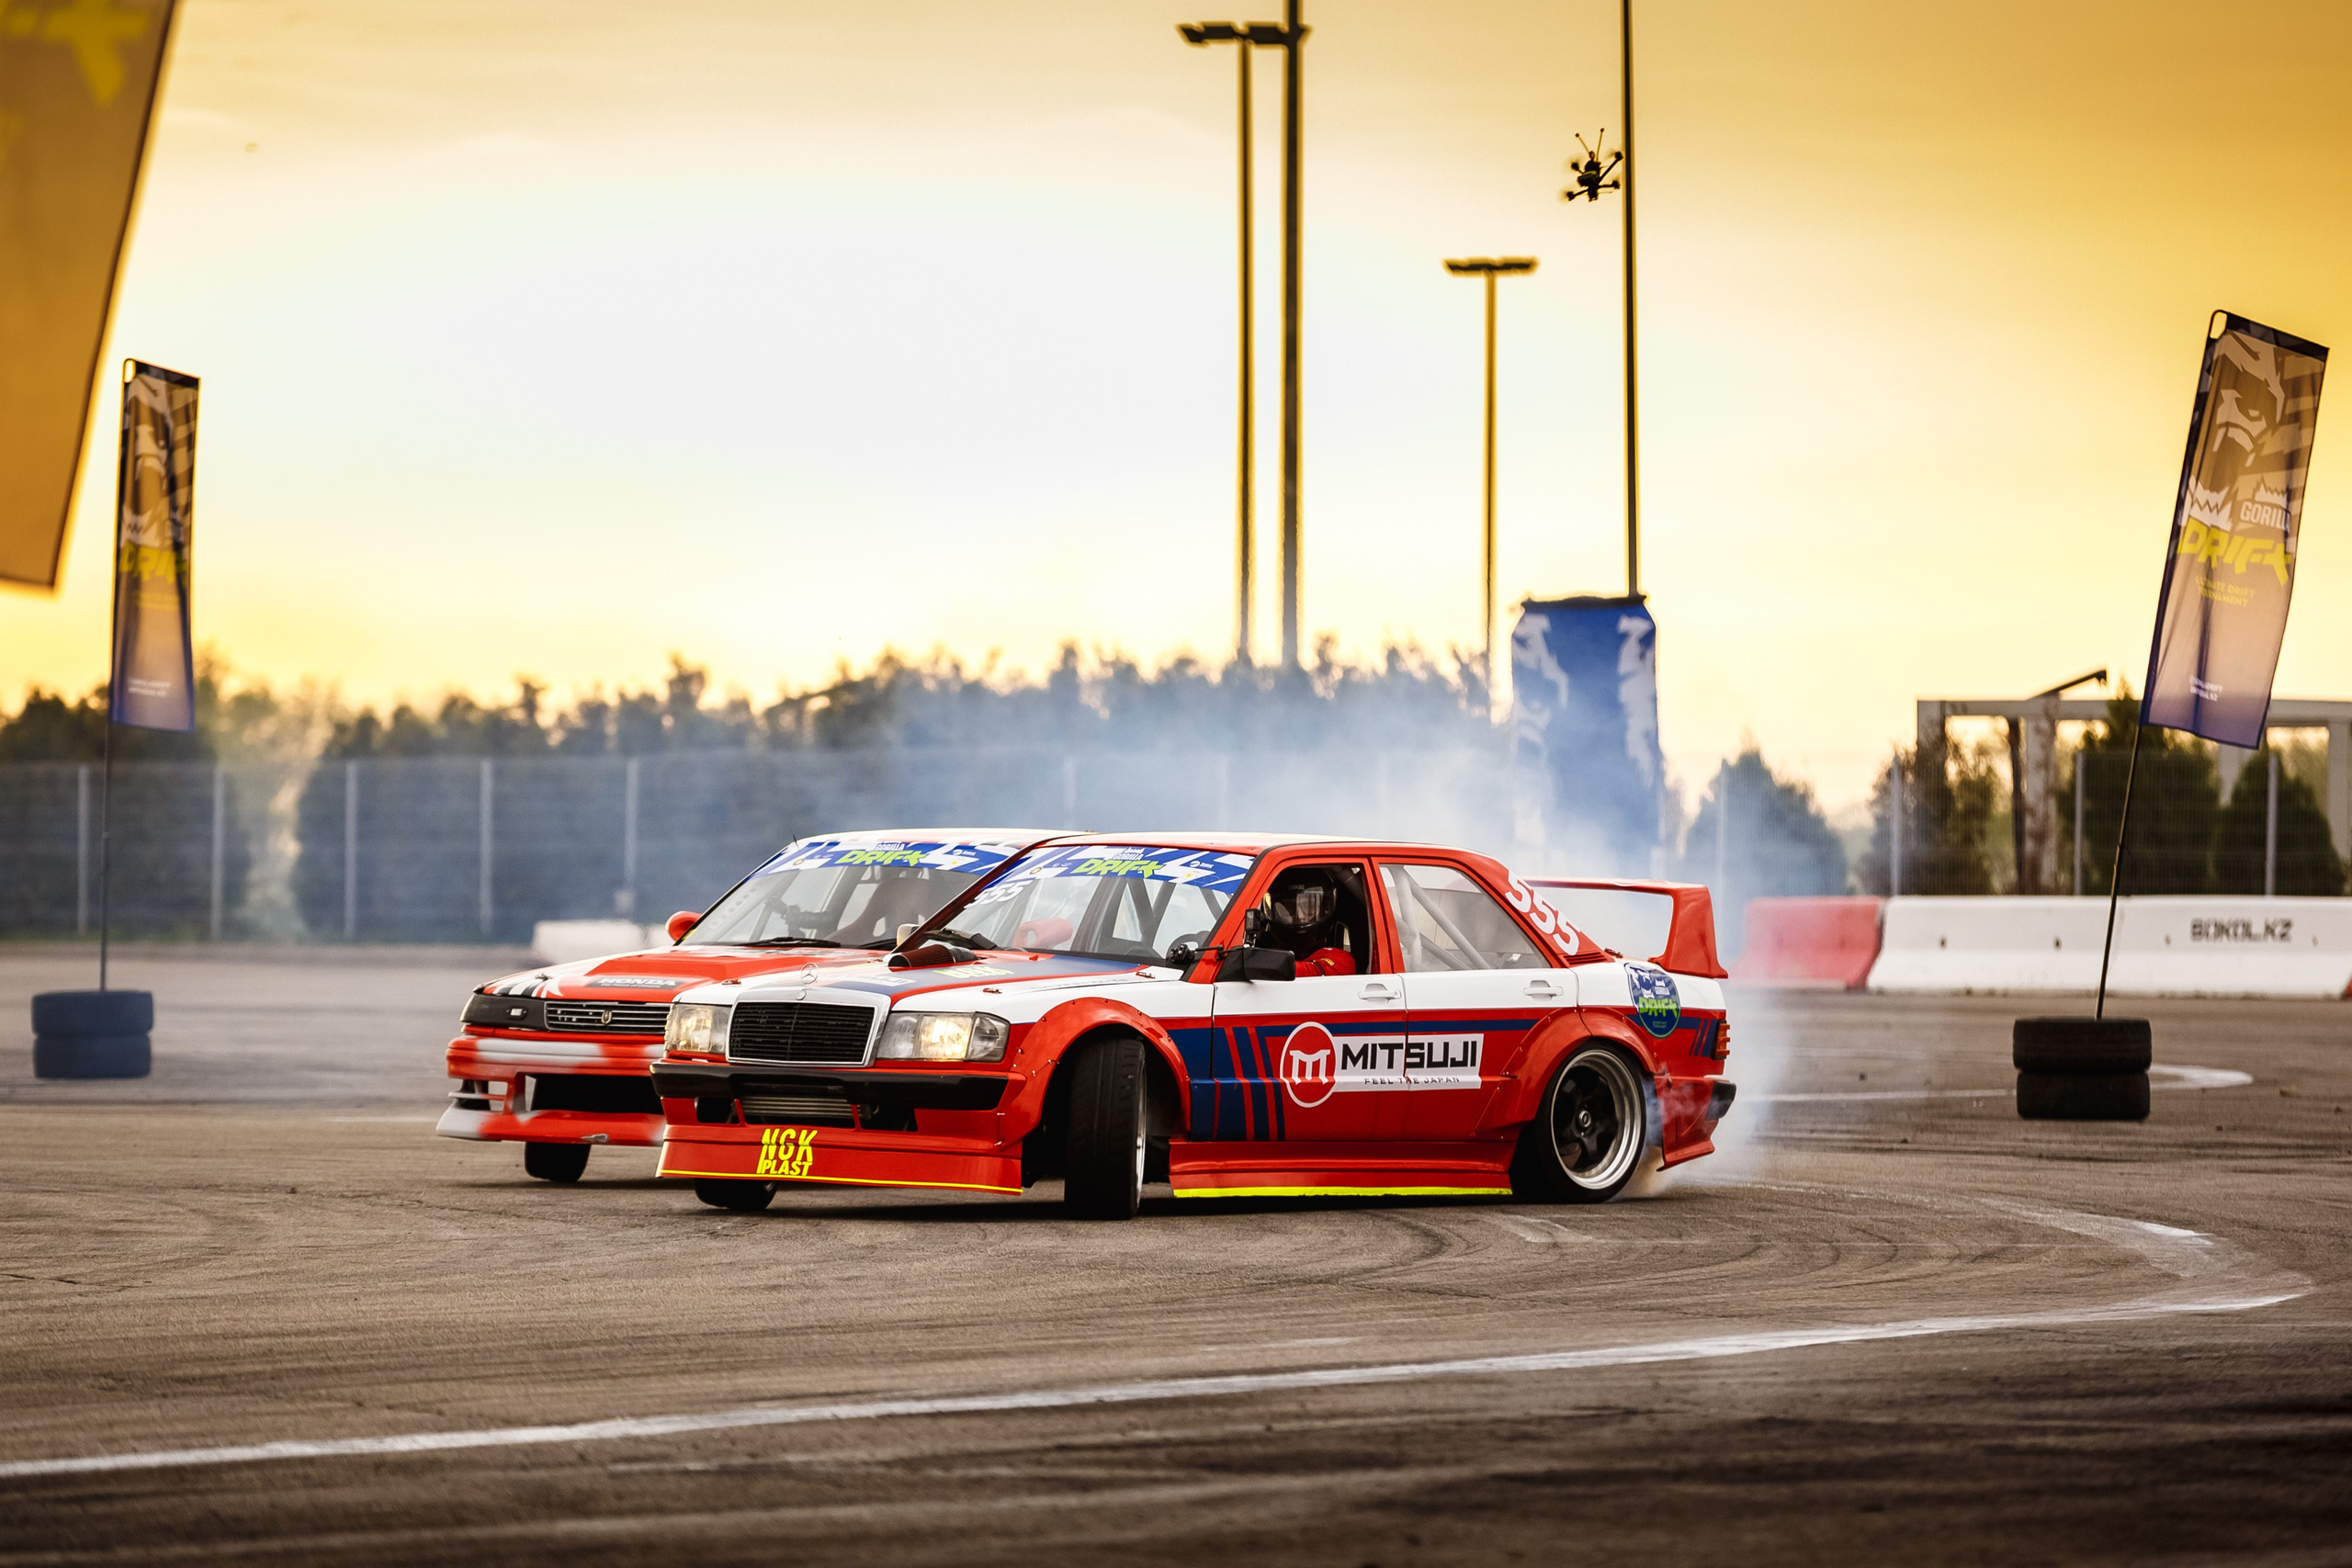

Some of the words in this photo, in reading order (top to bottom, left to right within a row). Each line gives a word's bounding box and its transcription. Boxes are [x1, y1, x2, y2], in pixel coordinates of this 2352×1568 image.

[2177, 516, 2292, 588] DRIFT
[834, 850, 928, 866] DRIFT
[1070, 859, 1164, 879] DRIFT
[1505, 869, 1582, 956] 555
[597, 977, 676, 987] HONDA
[1639, 997, 1679, 1019] DRIFT
[1340, 1041, 1477, 1071] MITSUJI
[1364, 1077, 1394, 1085] FEEL
[1423, 1076, 1461, 1085] JAPAN
[757, 1128, 819, 1174] NGK
[761, 1159, 813, 1176] PLAST
